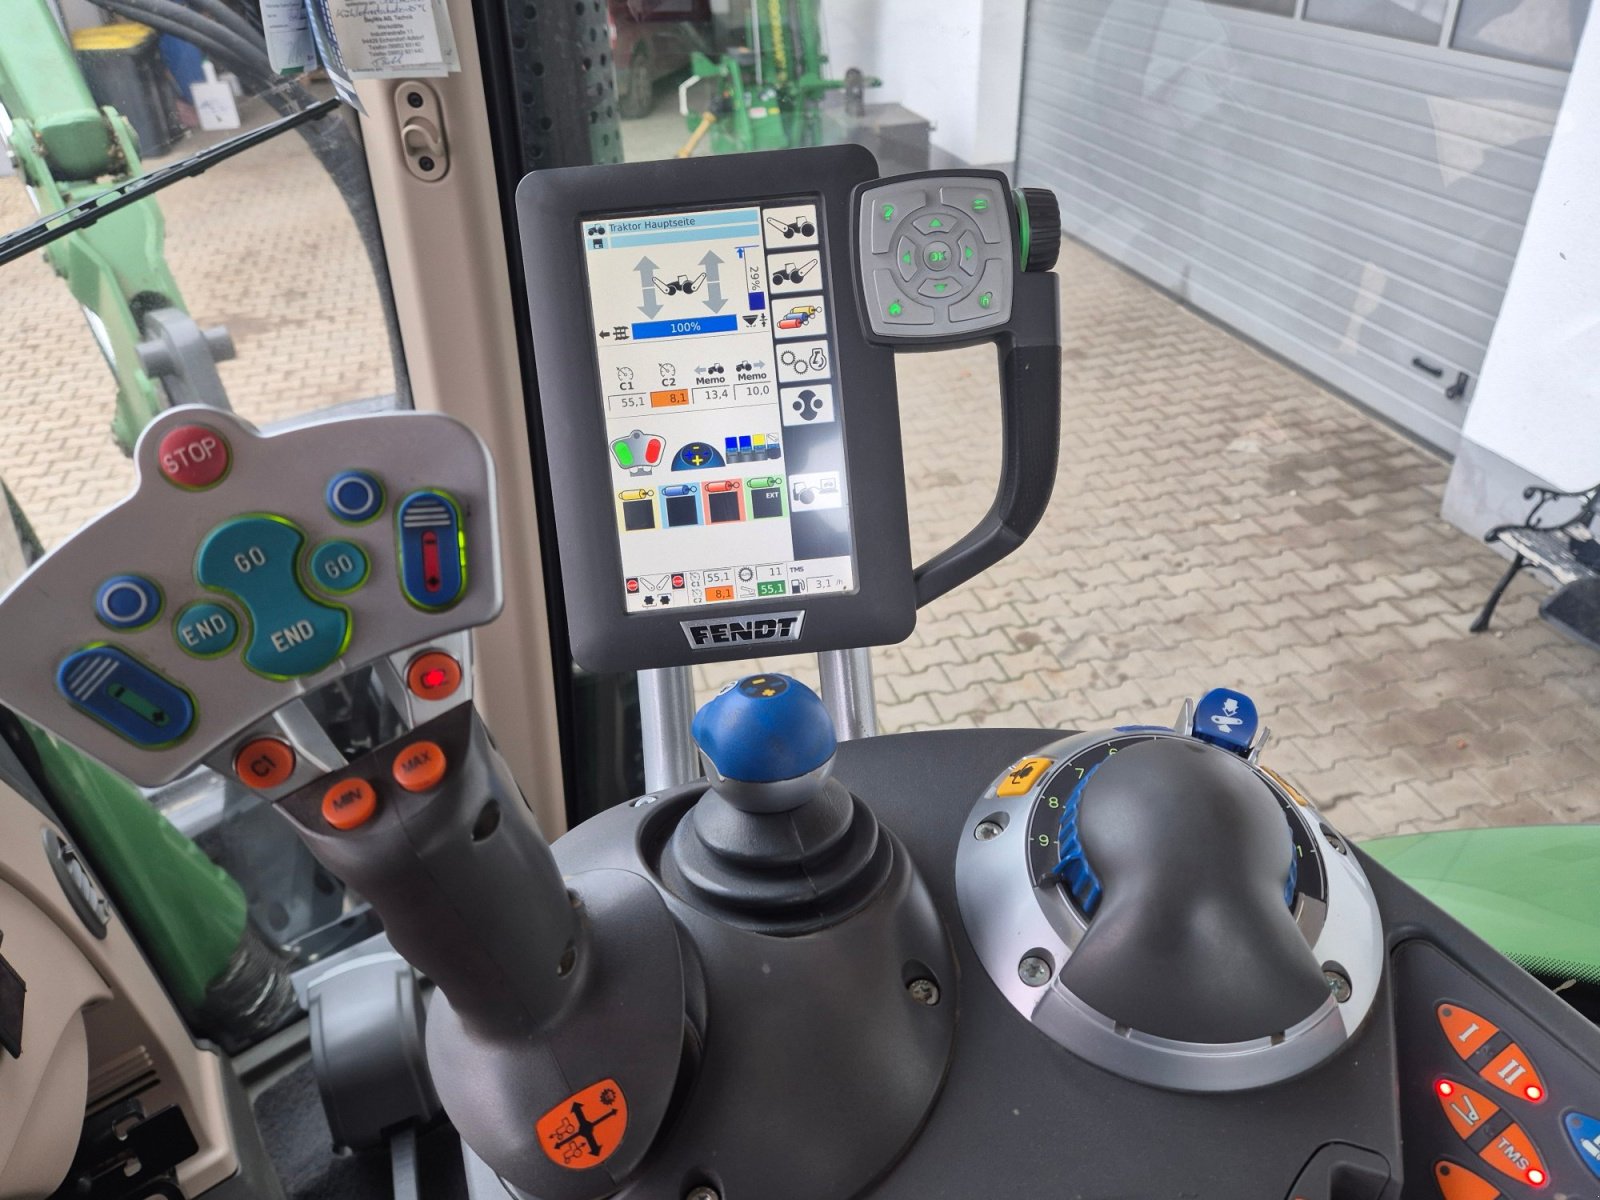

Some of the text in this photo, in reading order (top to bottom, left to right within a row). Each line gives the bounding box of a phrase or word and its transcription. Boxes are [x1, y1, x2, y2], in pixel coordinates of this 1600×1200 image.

[609, 216, 696, 232] Traktor Hauptseite
[928, 249, 948, 262] OK
[749, 265, 760, 291] 29%
[670, 321, 702, 333] 100%
[661, 377, 676, 387] C2
[695, 375, 726, 386] Memo
[737, 371, 767, 382] Memo
[619, 381, 634, 391] C1
[746, 385, 770, 398] 10,0
[669, 392, 687, 404] 8,1
[705, 388, 728, 401] 13,4
[621, 396, 645, 409] 55,1
[162, 436, 218, 474] STOP
[765, 491, 779, 500] EXT
[234, 546, 267, 573] GO
[324, 553, 354, 578] GO
[707, 572, 730, 584] 55,1
[770, 567, 781, 577] 11
[715, 589, 731, 600] 8,1
[761, 583, 784, 596] 55,1
[182, 613, 228, 647] END
[269, 618, 316, 654] END
[690, 617, 799, 645] FENDT
[250, 754, 277, 777] C1
[400, 750, 431, 775] MAX
[1075, 767, 1085, 779] 7
[331, 786, 363, 812] MIN
[1048, 796, 1059, 809] 8
[1038, 834, 1049, 847] 9
[1497, 1058, 1527, 1086] II
[1496, 1136, 1530, 1171] TMS
